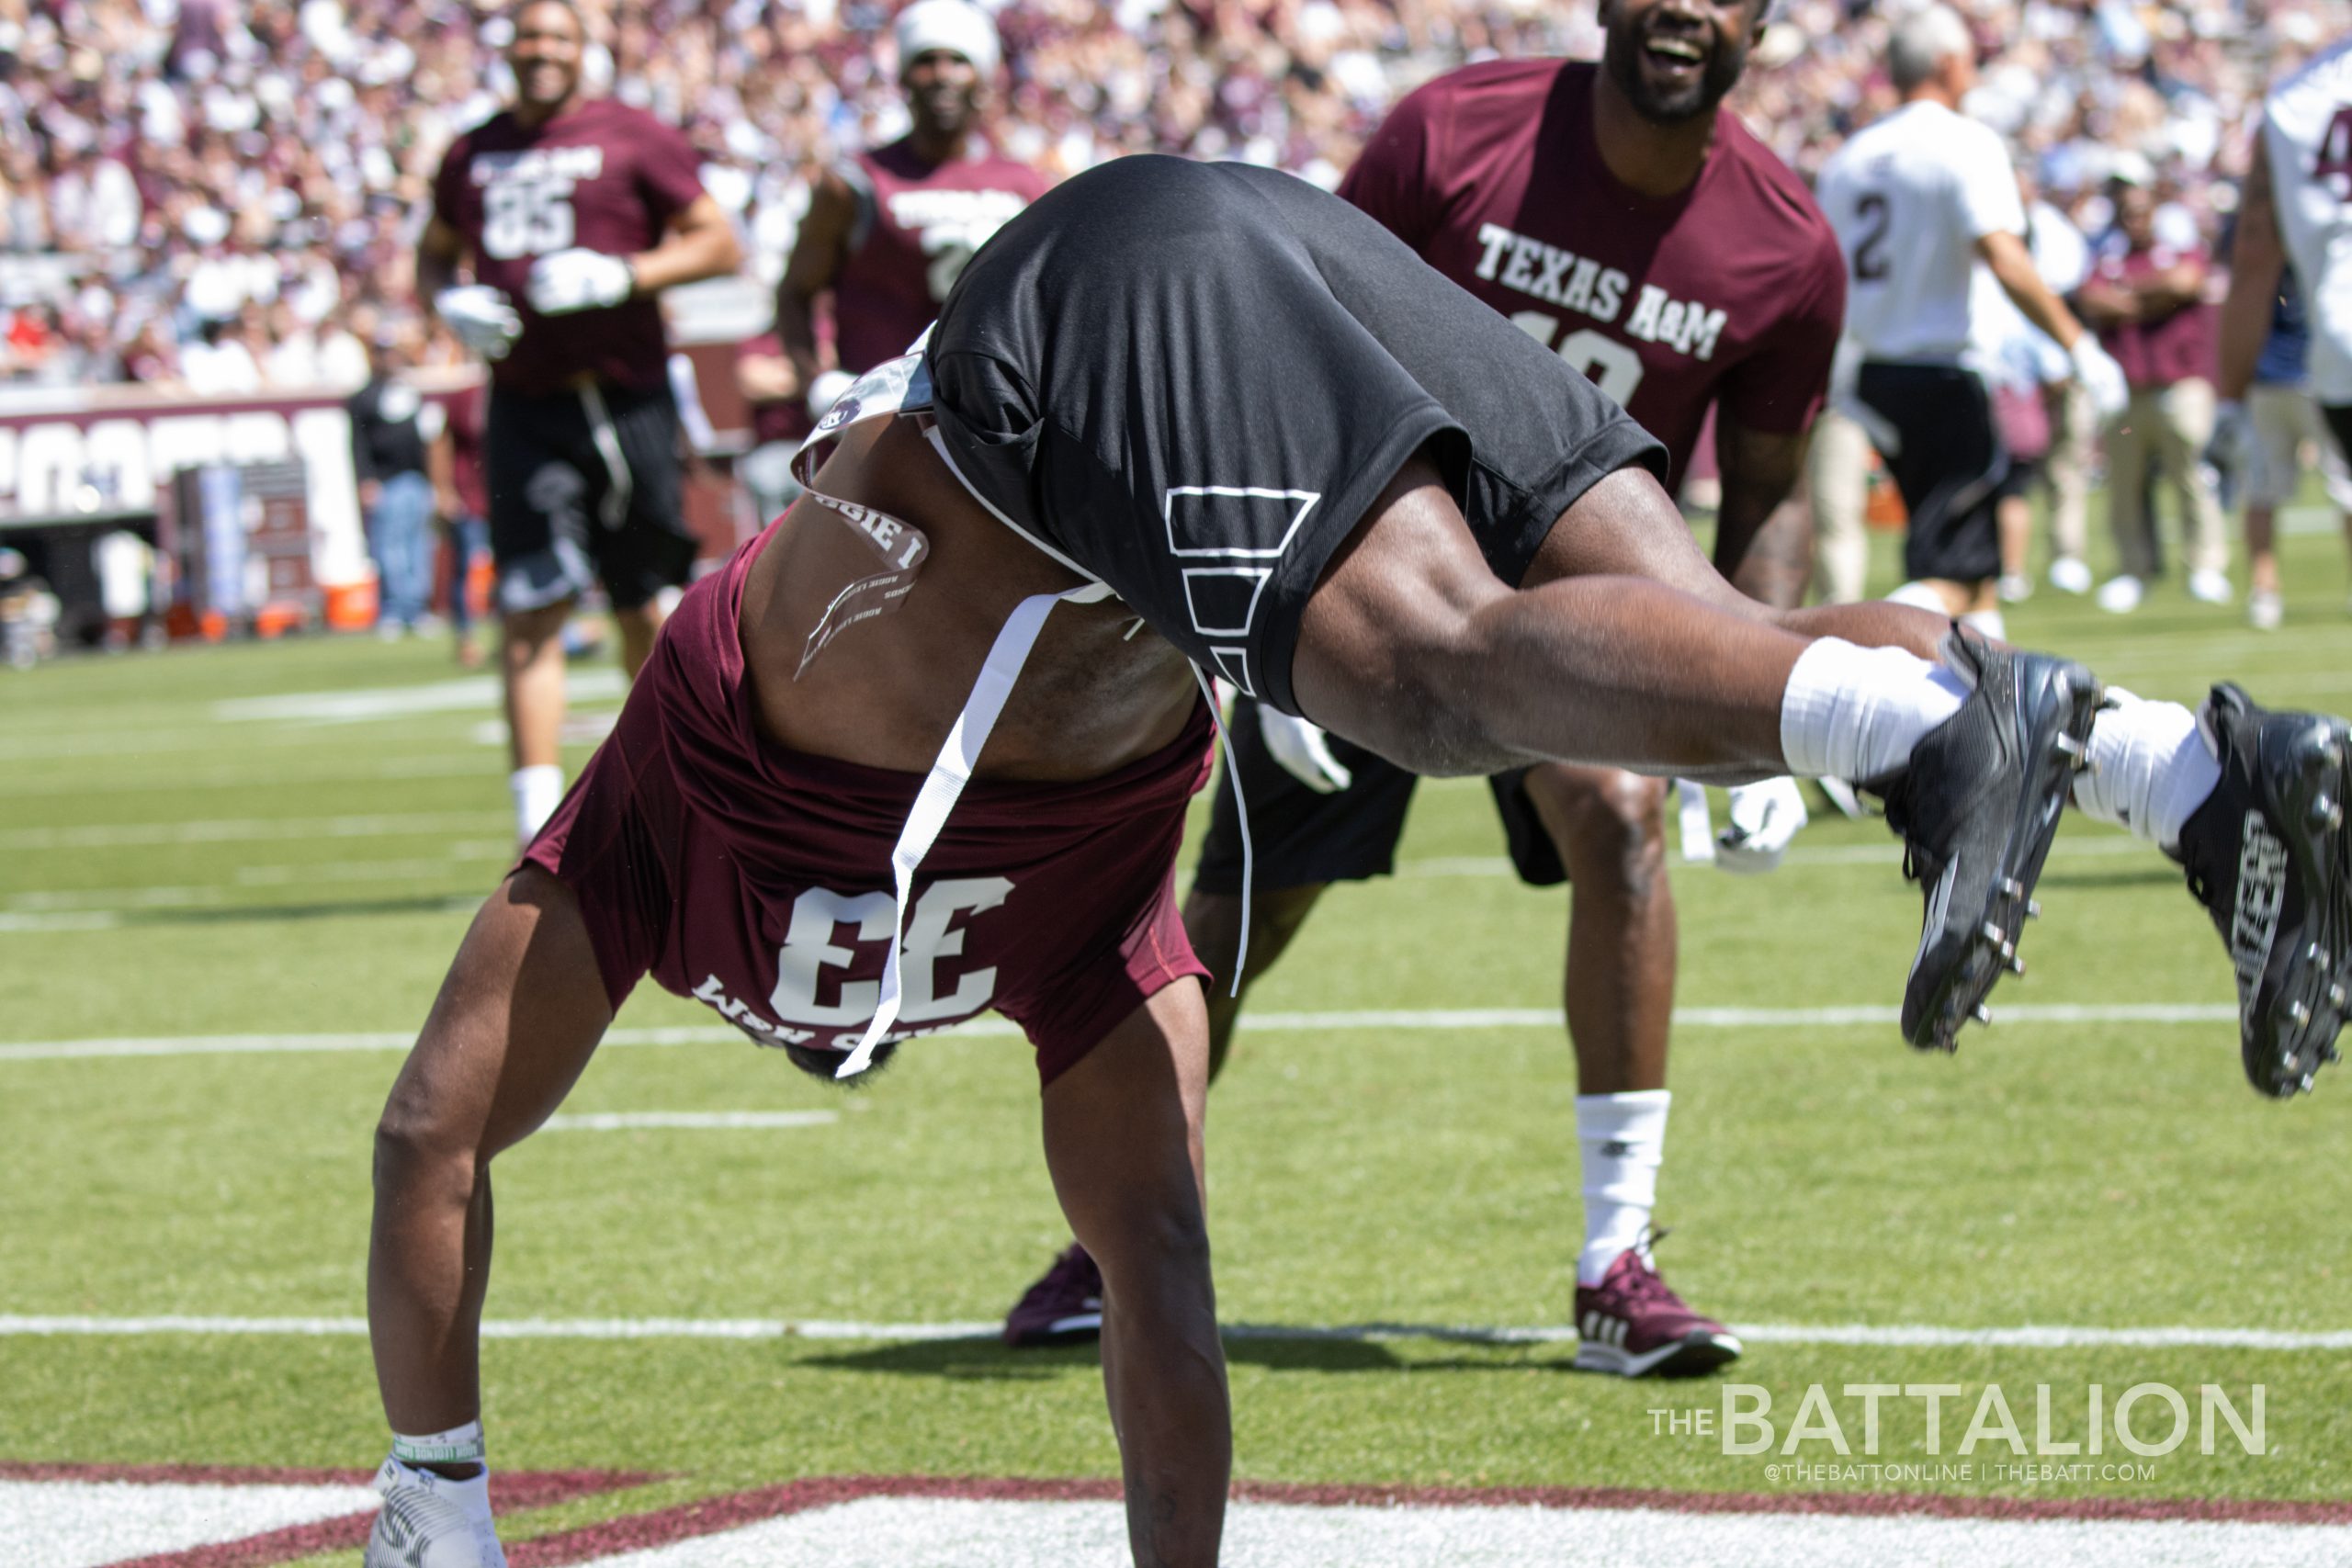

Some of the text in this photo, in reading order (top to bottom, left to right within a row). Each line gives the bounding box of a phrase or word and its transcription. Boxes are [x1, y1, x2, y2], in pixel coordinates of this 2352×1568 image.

[1476, 221, 1727, 361] TEXAS A&M
[1853, 190, 1892, 283] 2
[768, 875, 1016, 1028] 33
